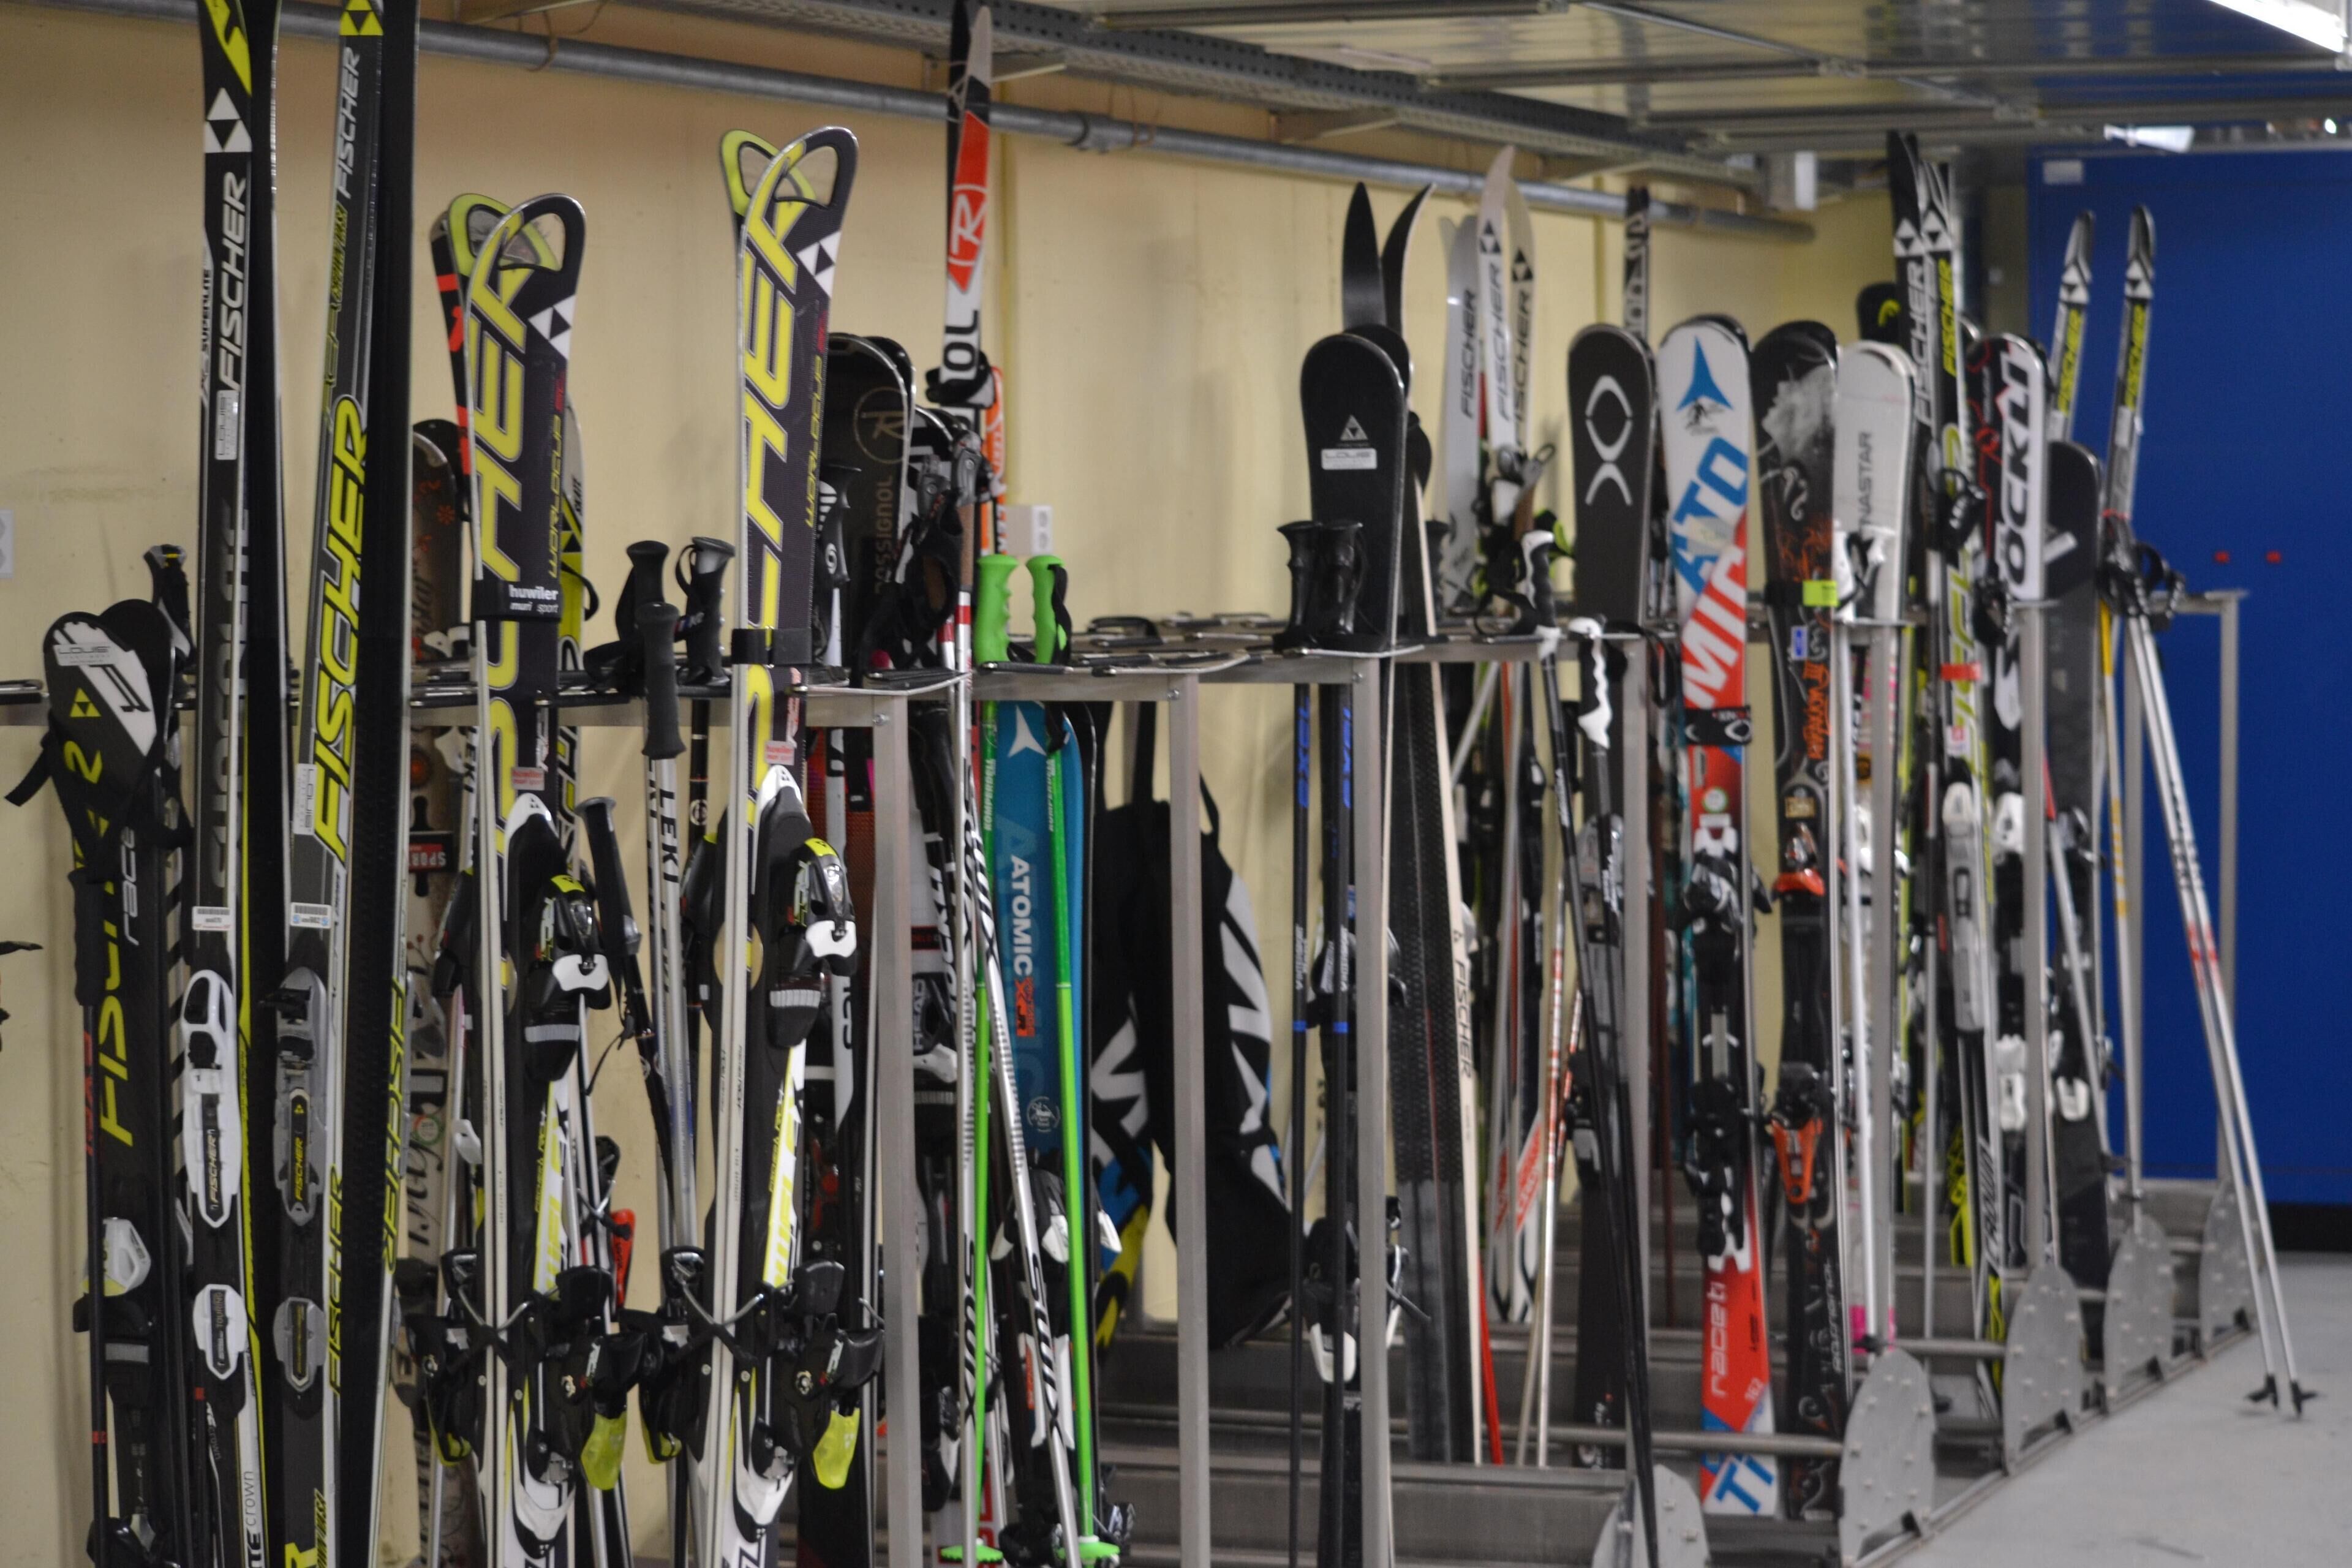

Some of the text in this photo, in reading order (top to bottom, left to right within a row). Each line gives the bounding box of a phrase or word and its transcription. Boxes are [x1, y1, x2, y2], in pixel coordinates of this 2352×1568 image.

[337, 47, 361, 199] FISCHER
[220, 171, 246, 391] FISCHER
[1460, 290, 1477, 420] FISCHER
[1487, 262, 1512, 423] FISCHER
[1906, 261, 1932, 427] FISCHER
[805, 355, 823, 528] WORLDCUP
[314, 398, 368, 865] FISCHER
[508, 584, 559, 601] huwiler
[510, 601, 559, 614] muri sport
[1298, 696, 1310, 809] EXEL
[409, 851, 447, 867] SPOR
[660, 789, 679, 883] LEKI
[1011, 854, 1034, 976] ATOMIC
[913, 979, 926, 1051] HEAD
[1455, 959, 1472, 1078] FISCHER
[208, 1134, 218, 1204] FISCHER
[295, 1137, 304, 1201] FISCHER
[330, 1163, 344, 1396] FISCHER
[244, 1471, 257, 1526] crown
